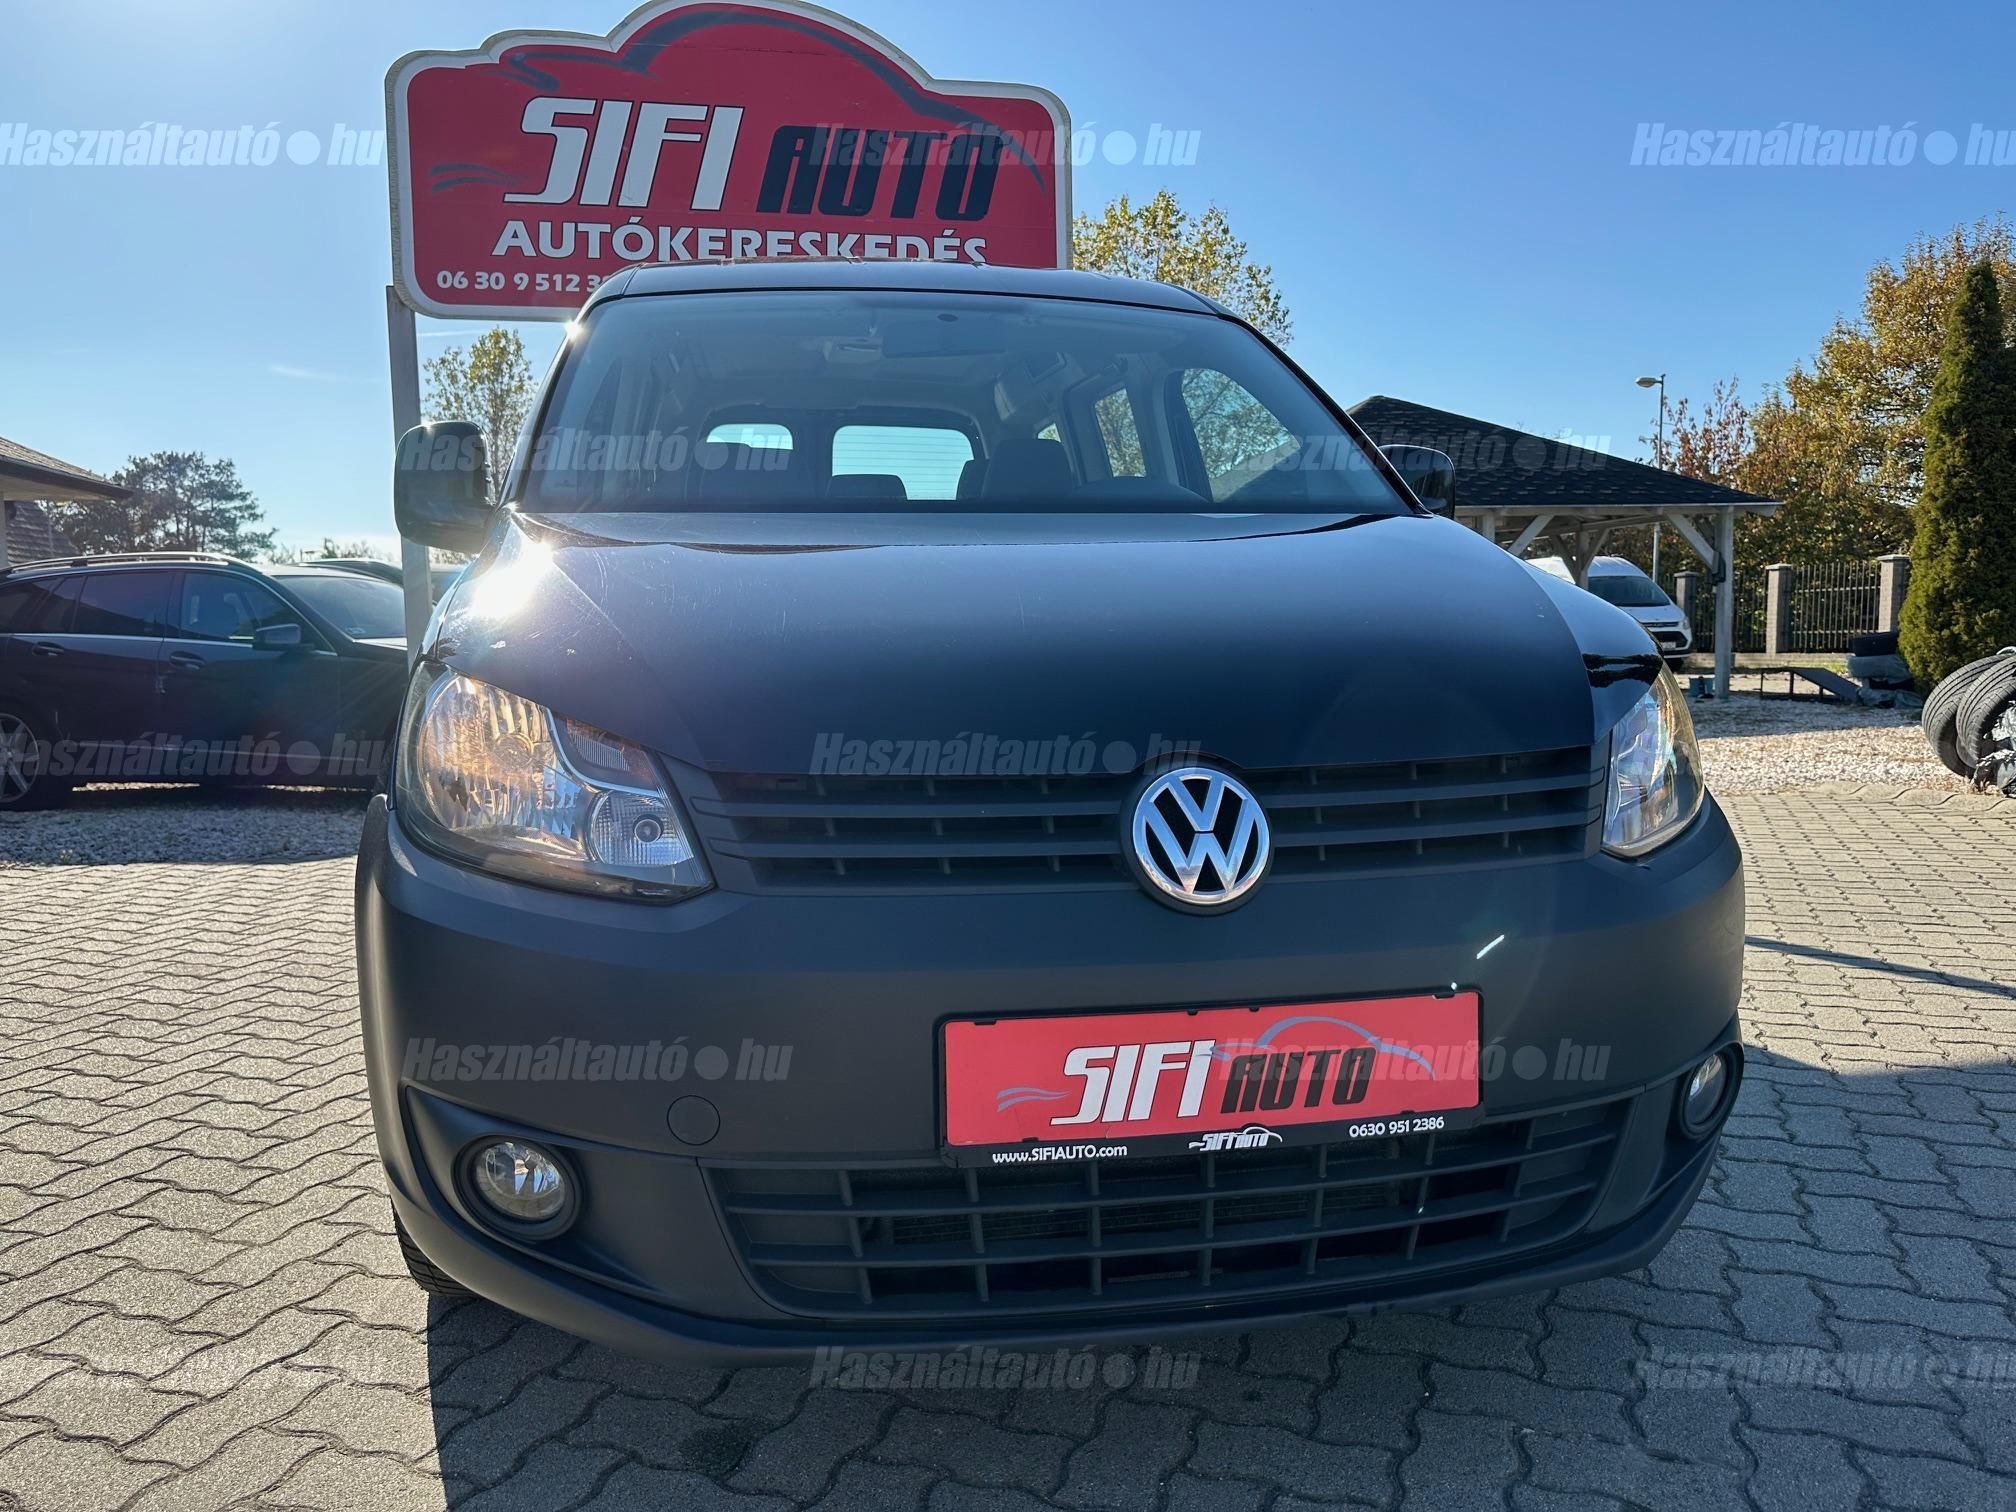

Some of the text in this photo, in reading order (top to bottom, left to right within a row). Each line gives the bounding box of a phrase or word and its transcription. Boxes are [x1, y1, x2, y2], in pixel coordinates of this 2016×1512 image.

[503, 96, 1003, 221] SIFI AUTO
[491, 216, 987, 263] AUTÓKERESKEDÉS
[436, 270, 468, 289] 06
[474, 271, 505, 290] 30
[1049, 1039, 1376, 1126] SIFI AUTO
[1349, 1116, 1445, 1139] 0630 951 2386
[992, 1145, 1128, 1164] www.SIFIAUTO.com
